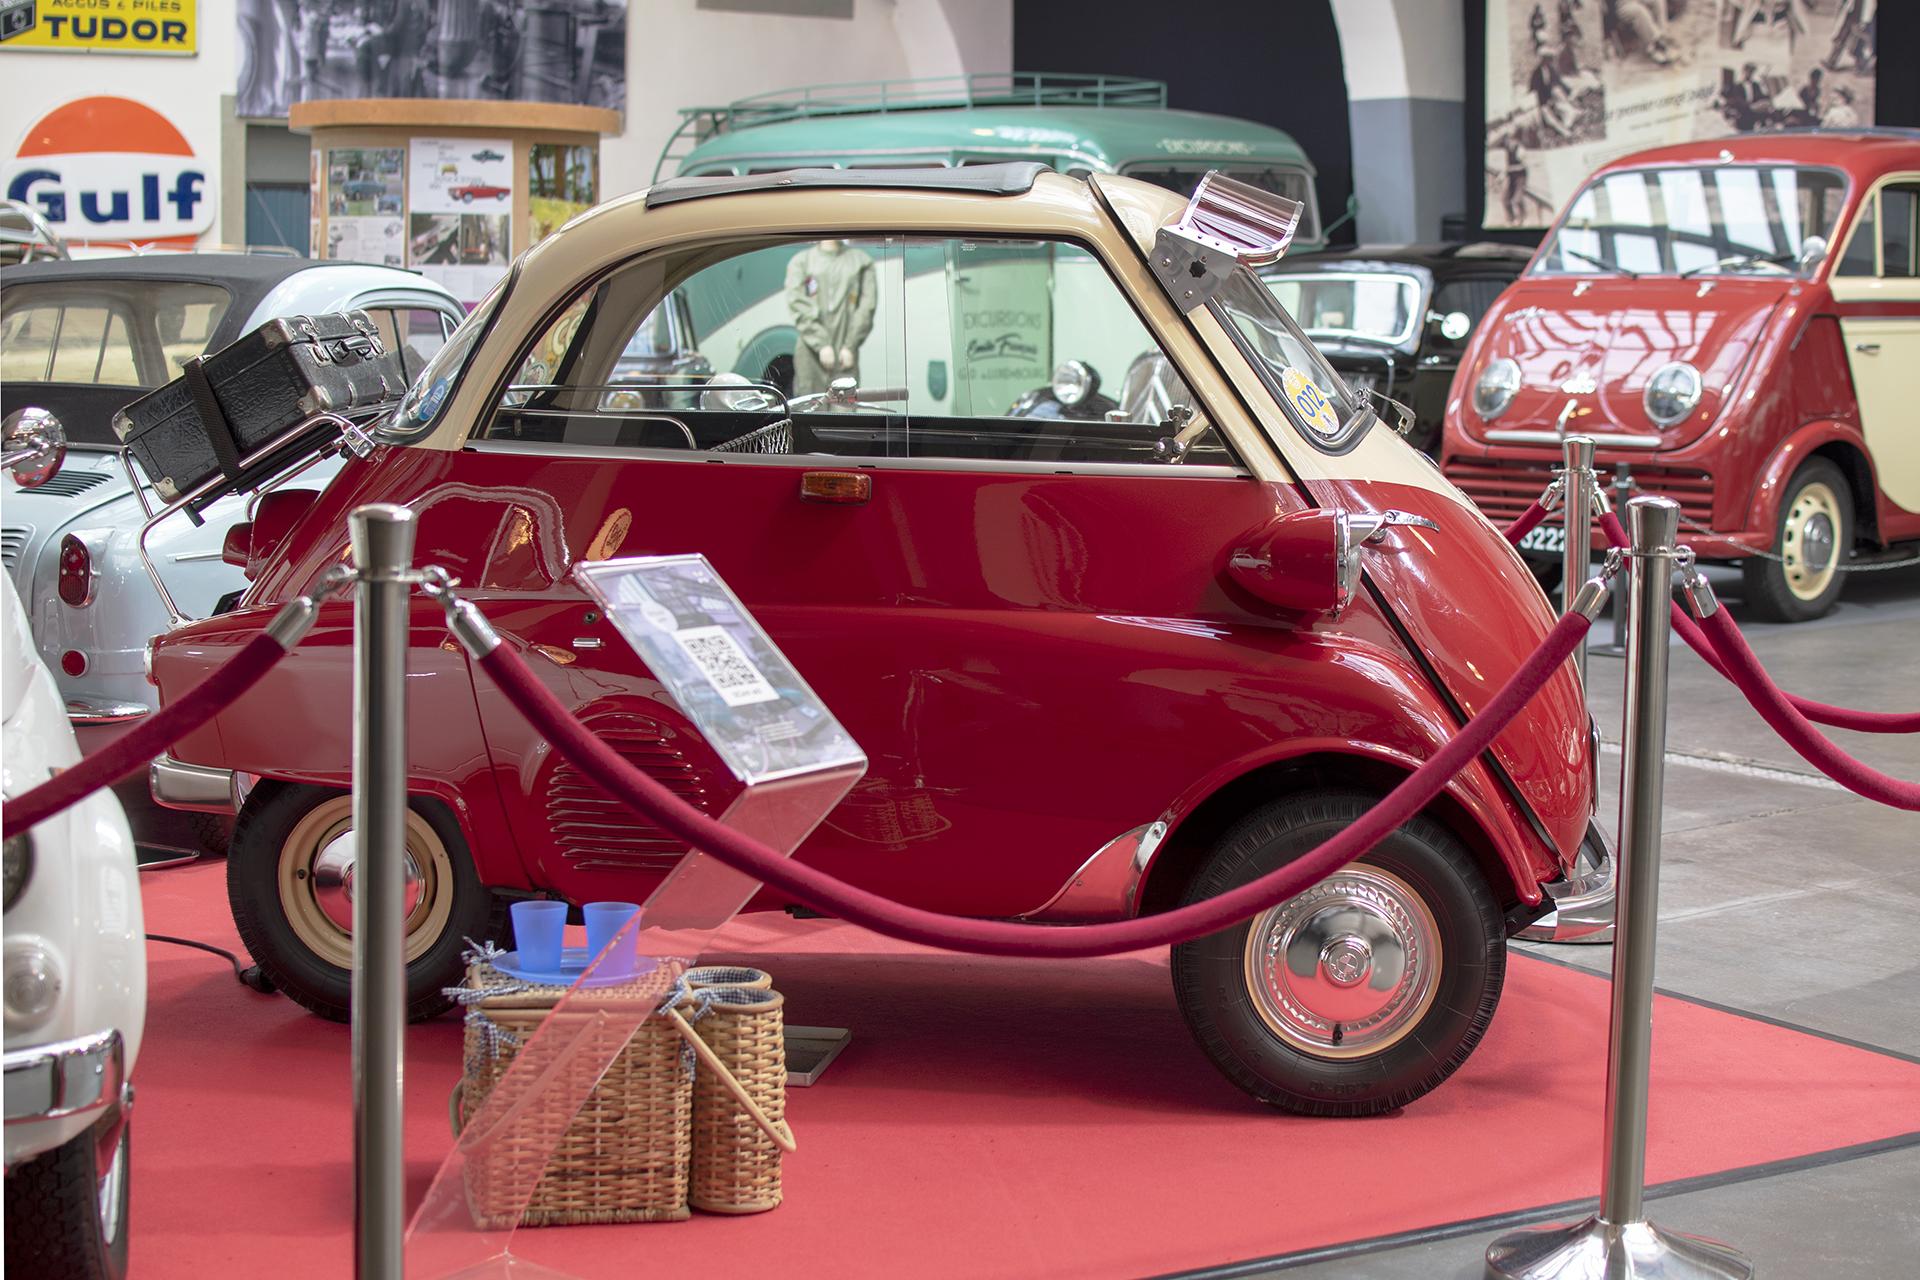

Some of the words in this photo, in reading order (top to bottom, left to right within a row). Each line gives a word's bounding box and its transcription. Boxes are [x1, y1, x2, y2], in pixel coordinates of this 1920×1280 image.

[51, 0, 109, 9] ACCUS
[133, 0, 181, 13] PILES
[43, 15, 188, 43] TUDOR
[7, 169, 206, 223] Gulf
[1296, 384, 1325, 418] 012
